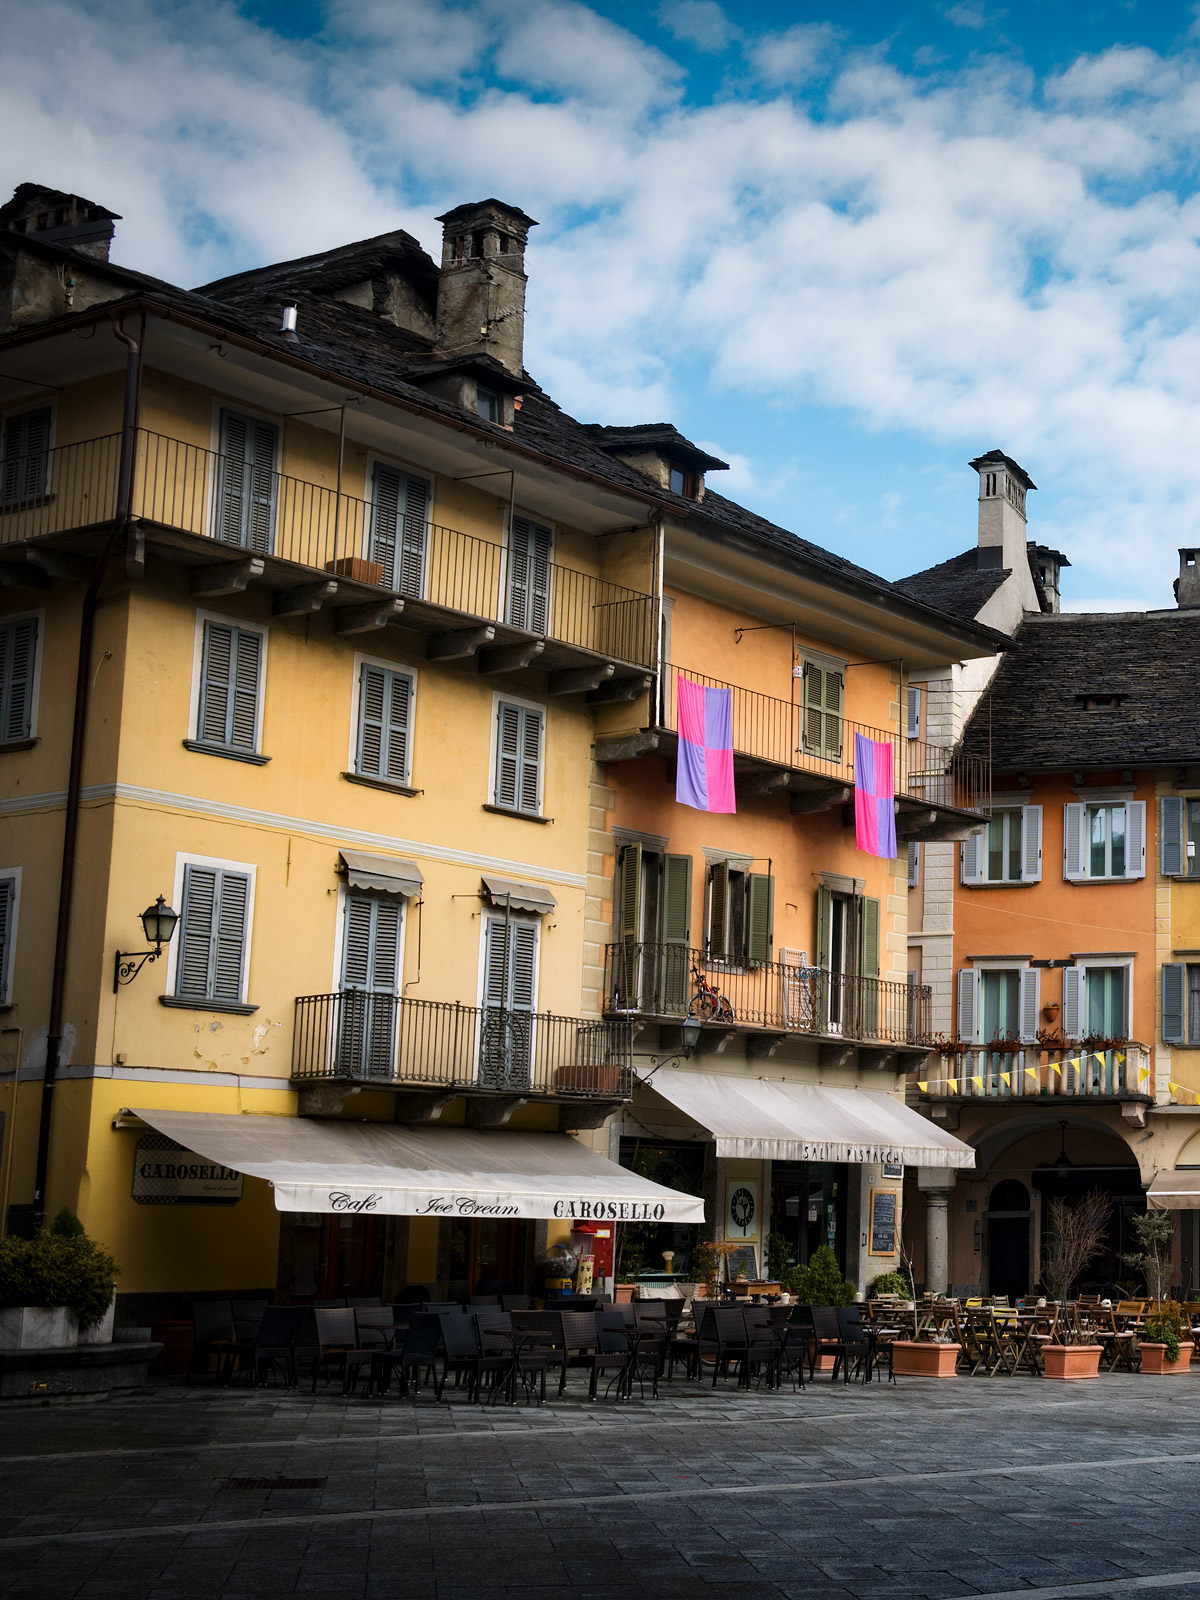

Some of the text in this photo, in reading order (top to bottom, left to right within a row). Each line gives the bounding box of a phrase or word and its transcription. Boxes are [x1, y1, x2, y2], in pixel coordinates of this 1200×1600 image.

[847, 1149, 904, 1164] PISTACCHI
[140, 1163, 240, 1181] CAROSELLO
[328, 1191, 521, 1216] Café Ice Cream
[553, 1200, 666, 1220] CAROSELLO
